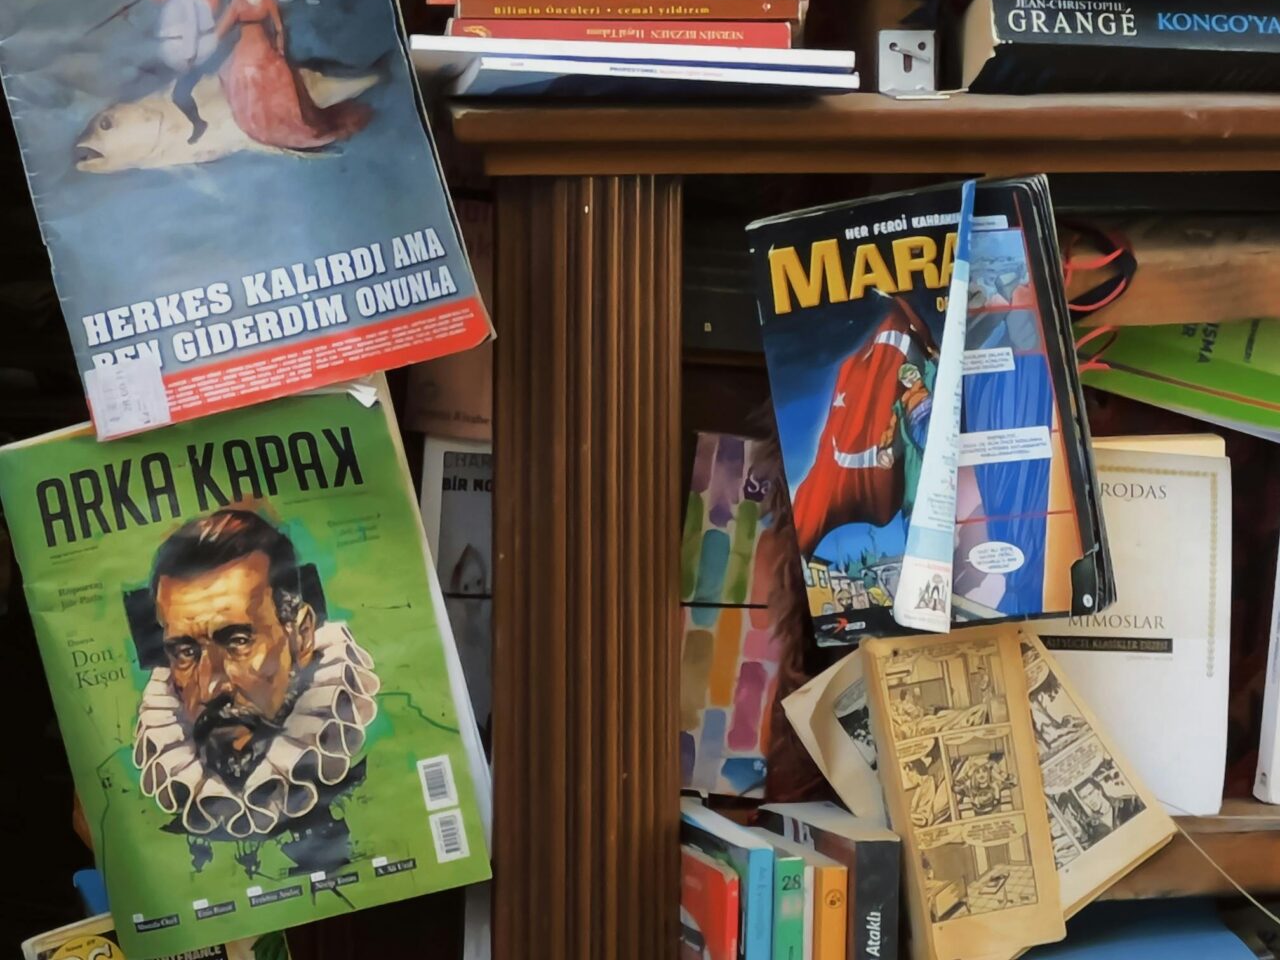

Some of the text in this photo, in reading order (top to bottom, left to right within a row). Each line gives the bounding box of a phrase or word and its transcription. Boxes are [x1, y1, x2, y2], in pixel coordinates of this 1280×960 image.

[494, 4, 710, 16] Bilimin Öncüleri cemal yıldırım
[1008, 7, 1138, 37] GRANGÉ
[651, 30, 744, 40] NERMİN BEZMEN
[845, 214, 908, 240] HER FERDİ
[82, 228, 446, 346] HERKES KALIRDI AMA
[172, 294, 347, 363] GİDERDİM
[355, 265, 457, 318] ONUNLA
[36, 451, 181, 547] ARKA
[1100, 483, 1167, 501] RODAS
[72, 648, 113, 668] Don
[76, 667, 126, 689] Kişot
[866, 911, 881, 956] Ataklı
